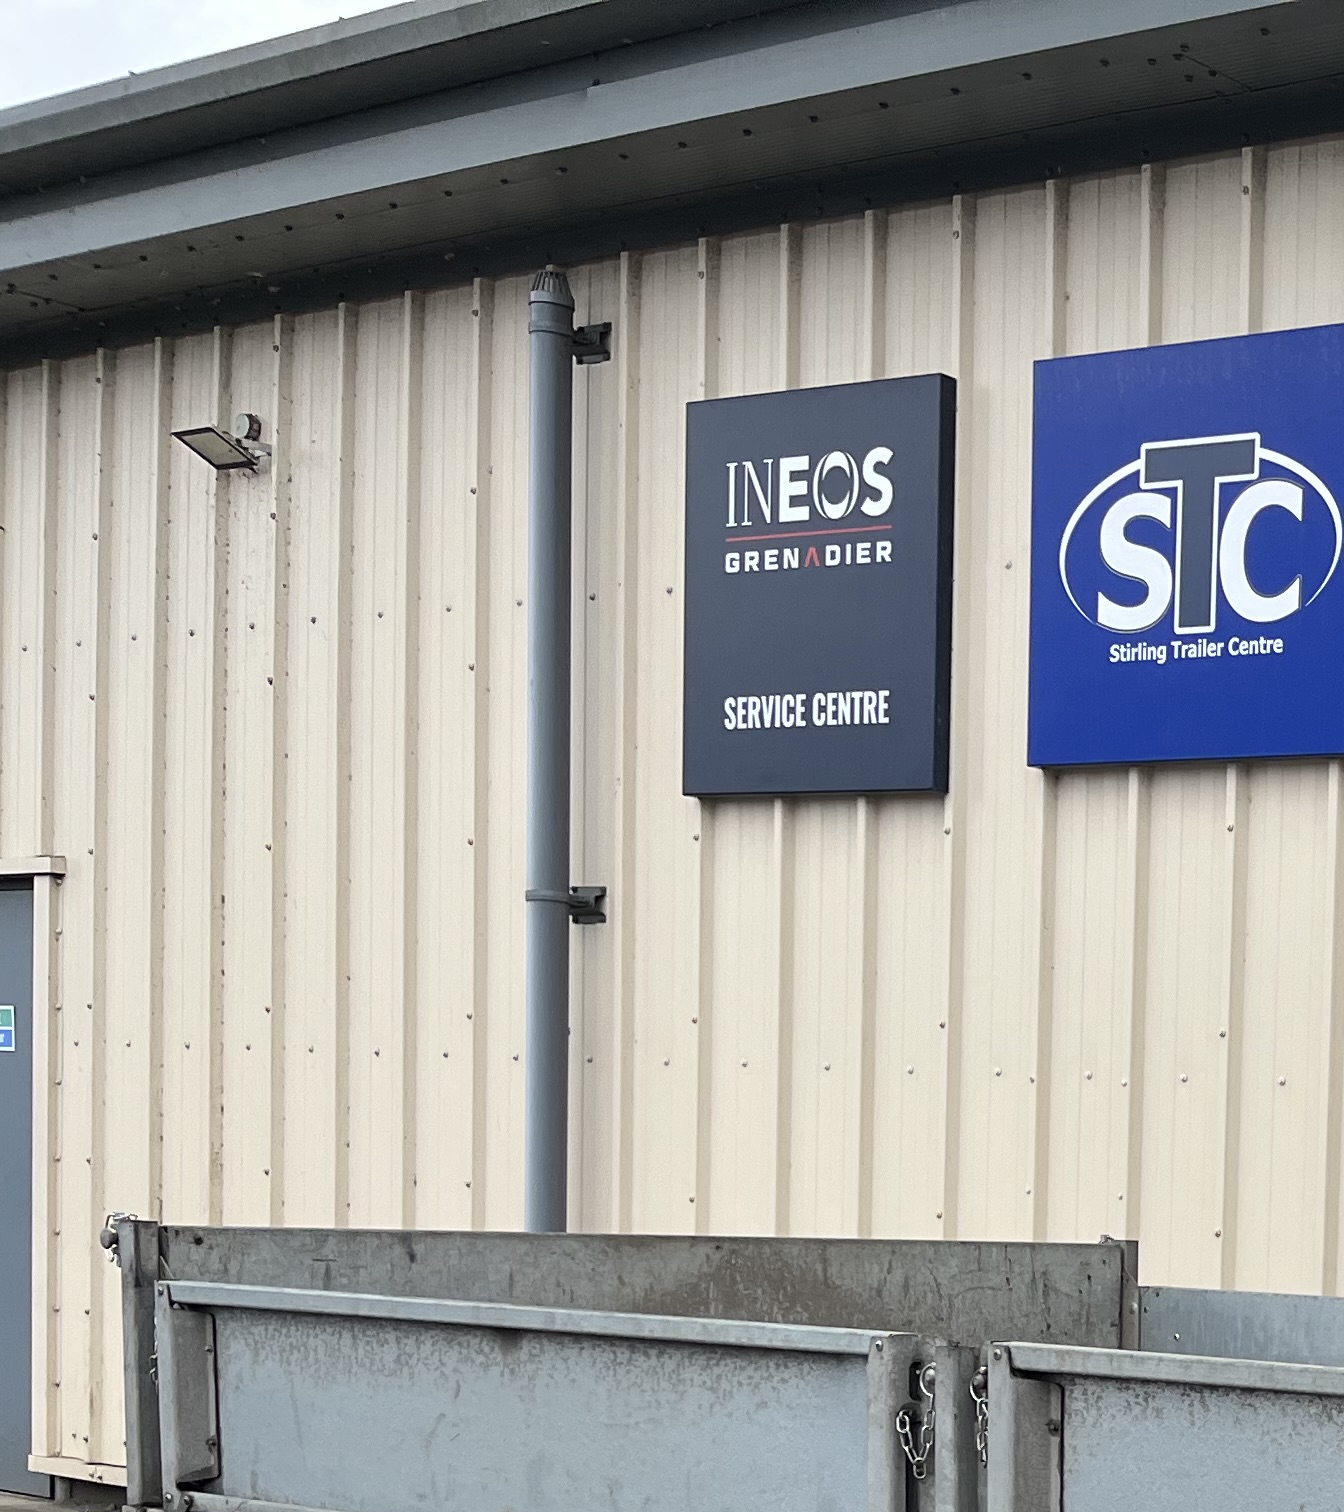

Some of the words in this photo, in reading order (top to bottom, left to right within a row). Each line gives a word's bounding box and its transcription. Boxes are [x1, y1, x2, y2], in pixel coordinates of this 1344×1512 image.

[725, 446, 894, 527] INEOS
[1097, 431, 1304, 634] STC
[725, 540, 892, 574] GRENADIER
[1109, 641, 1167, 664] Stirling
[1171, 636, 1225, 659] Trailer
[1227, 635, 1284, 656] Centre
[724, 693, 807, 730] SERVICE
[812, 689, 890, 726] CENTRE
